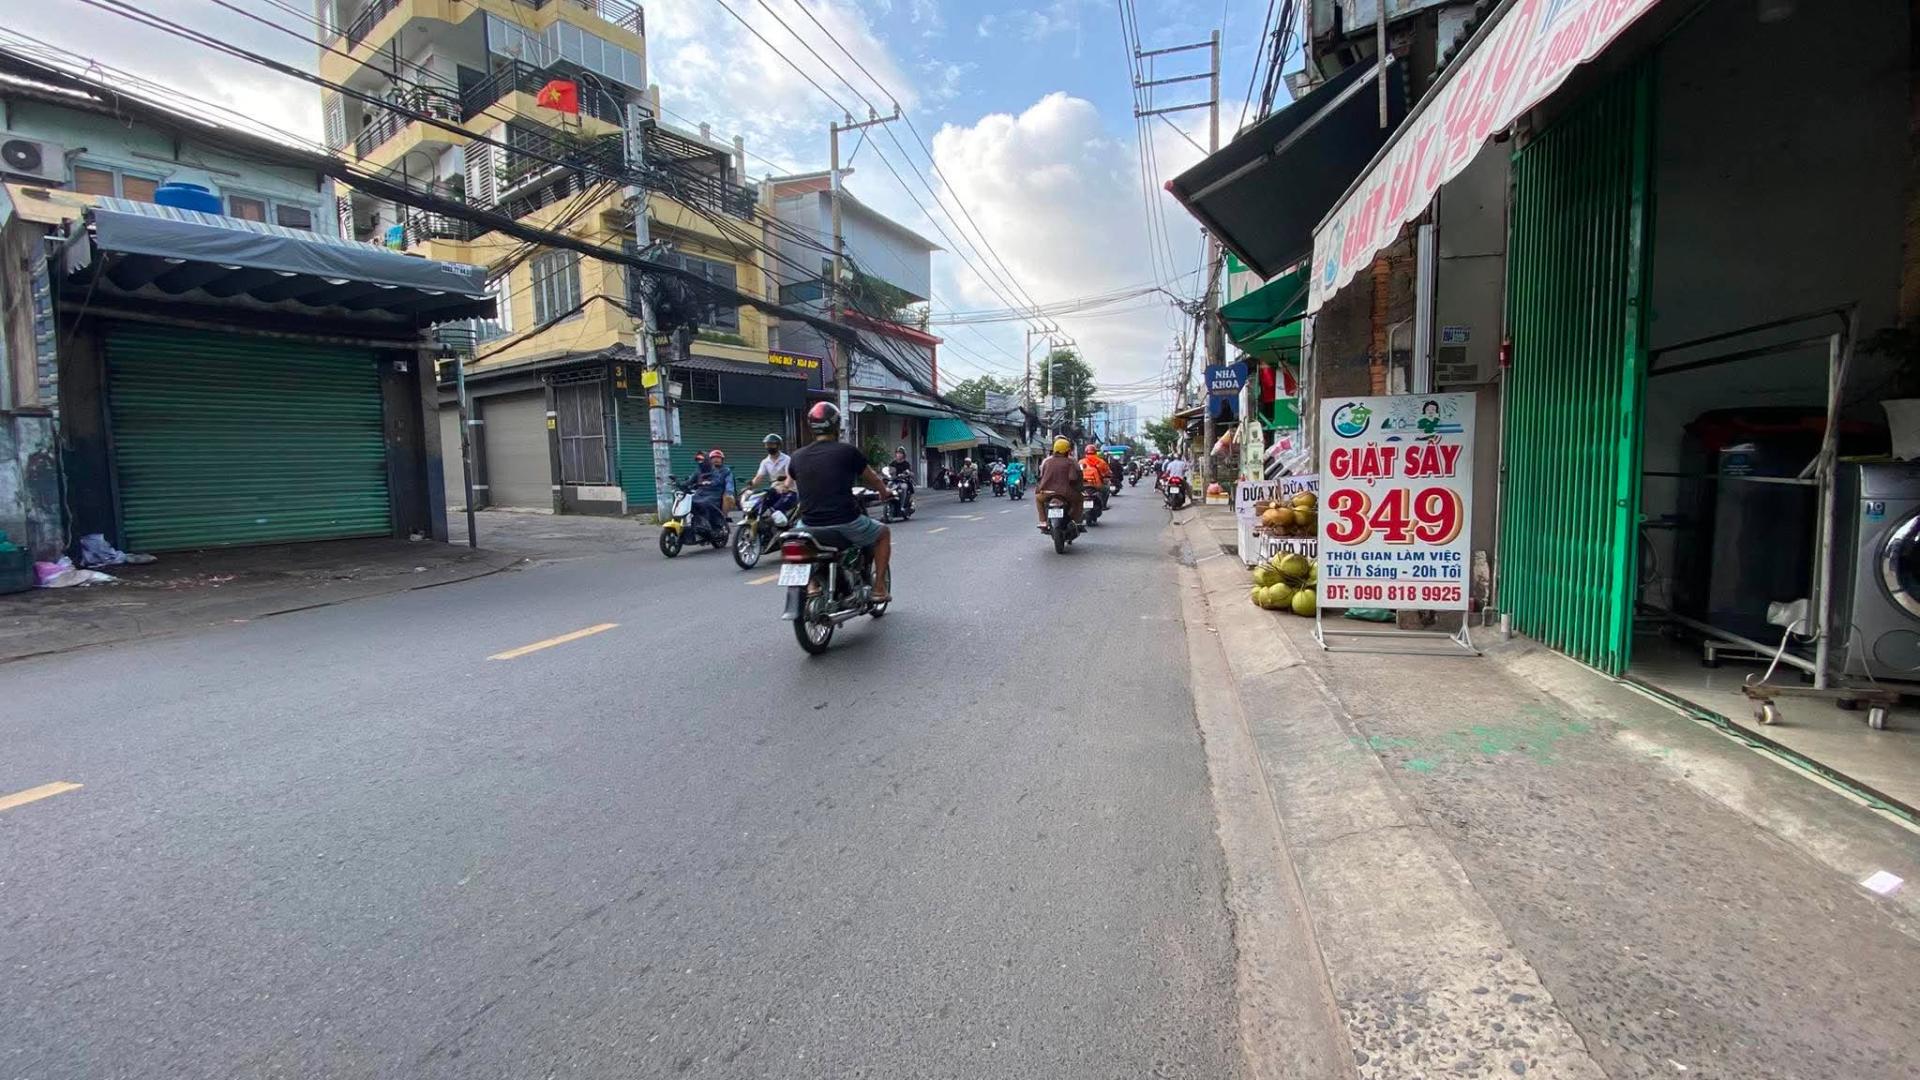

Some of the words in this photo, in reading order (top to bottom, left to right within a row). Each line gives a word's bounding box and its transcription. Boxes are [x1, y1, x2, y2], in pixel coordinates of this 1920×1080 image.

[1215, 370, 1237, 379] NHA
[1212, 380, 1240, 389] KHOA
[1329, 442, 1397, 486] GIẶT
[1403, 435, 1462, 478] SẤY
[1243, 484, 1264, 501] DỪA
[1283, 480, 1304, 494] DỪA
[1326, 487, 1463, 546] 349
[1326, 550, 1356, 561] THỜI
[1361, 551, 1392, 561] GIAN
[1397, 550, 1424, 561] LÀM
[1430, 550, 1461, 563] VIỆC
[1327, 564, 1342, 576] Từ
[1346, 565, 1361, 577] 7h
[1366, 564, 1397, 579] Sáng
[1412, 565, 1437, 578] 20h
[1441, 563, 1461, 578] Tối
[1327, 585, 1349, 600] ĐT:
[1354, 585, 1382, 600] 090
[1388, 586, 1416, 601] 818
[1422, 586, 1461, 602] 9925
